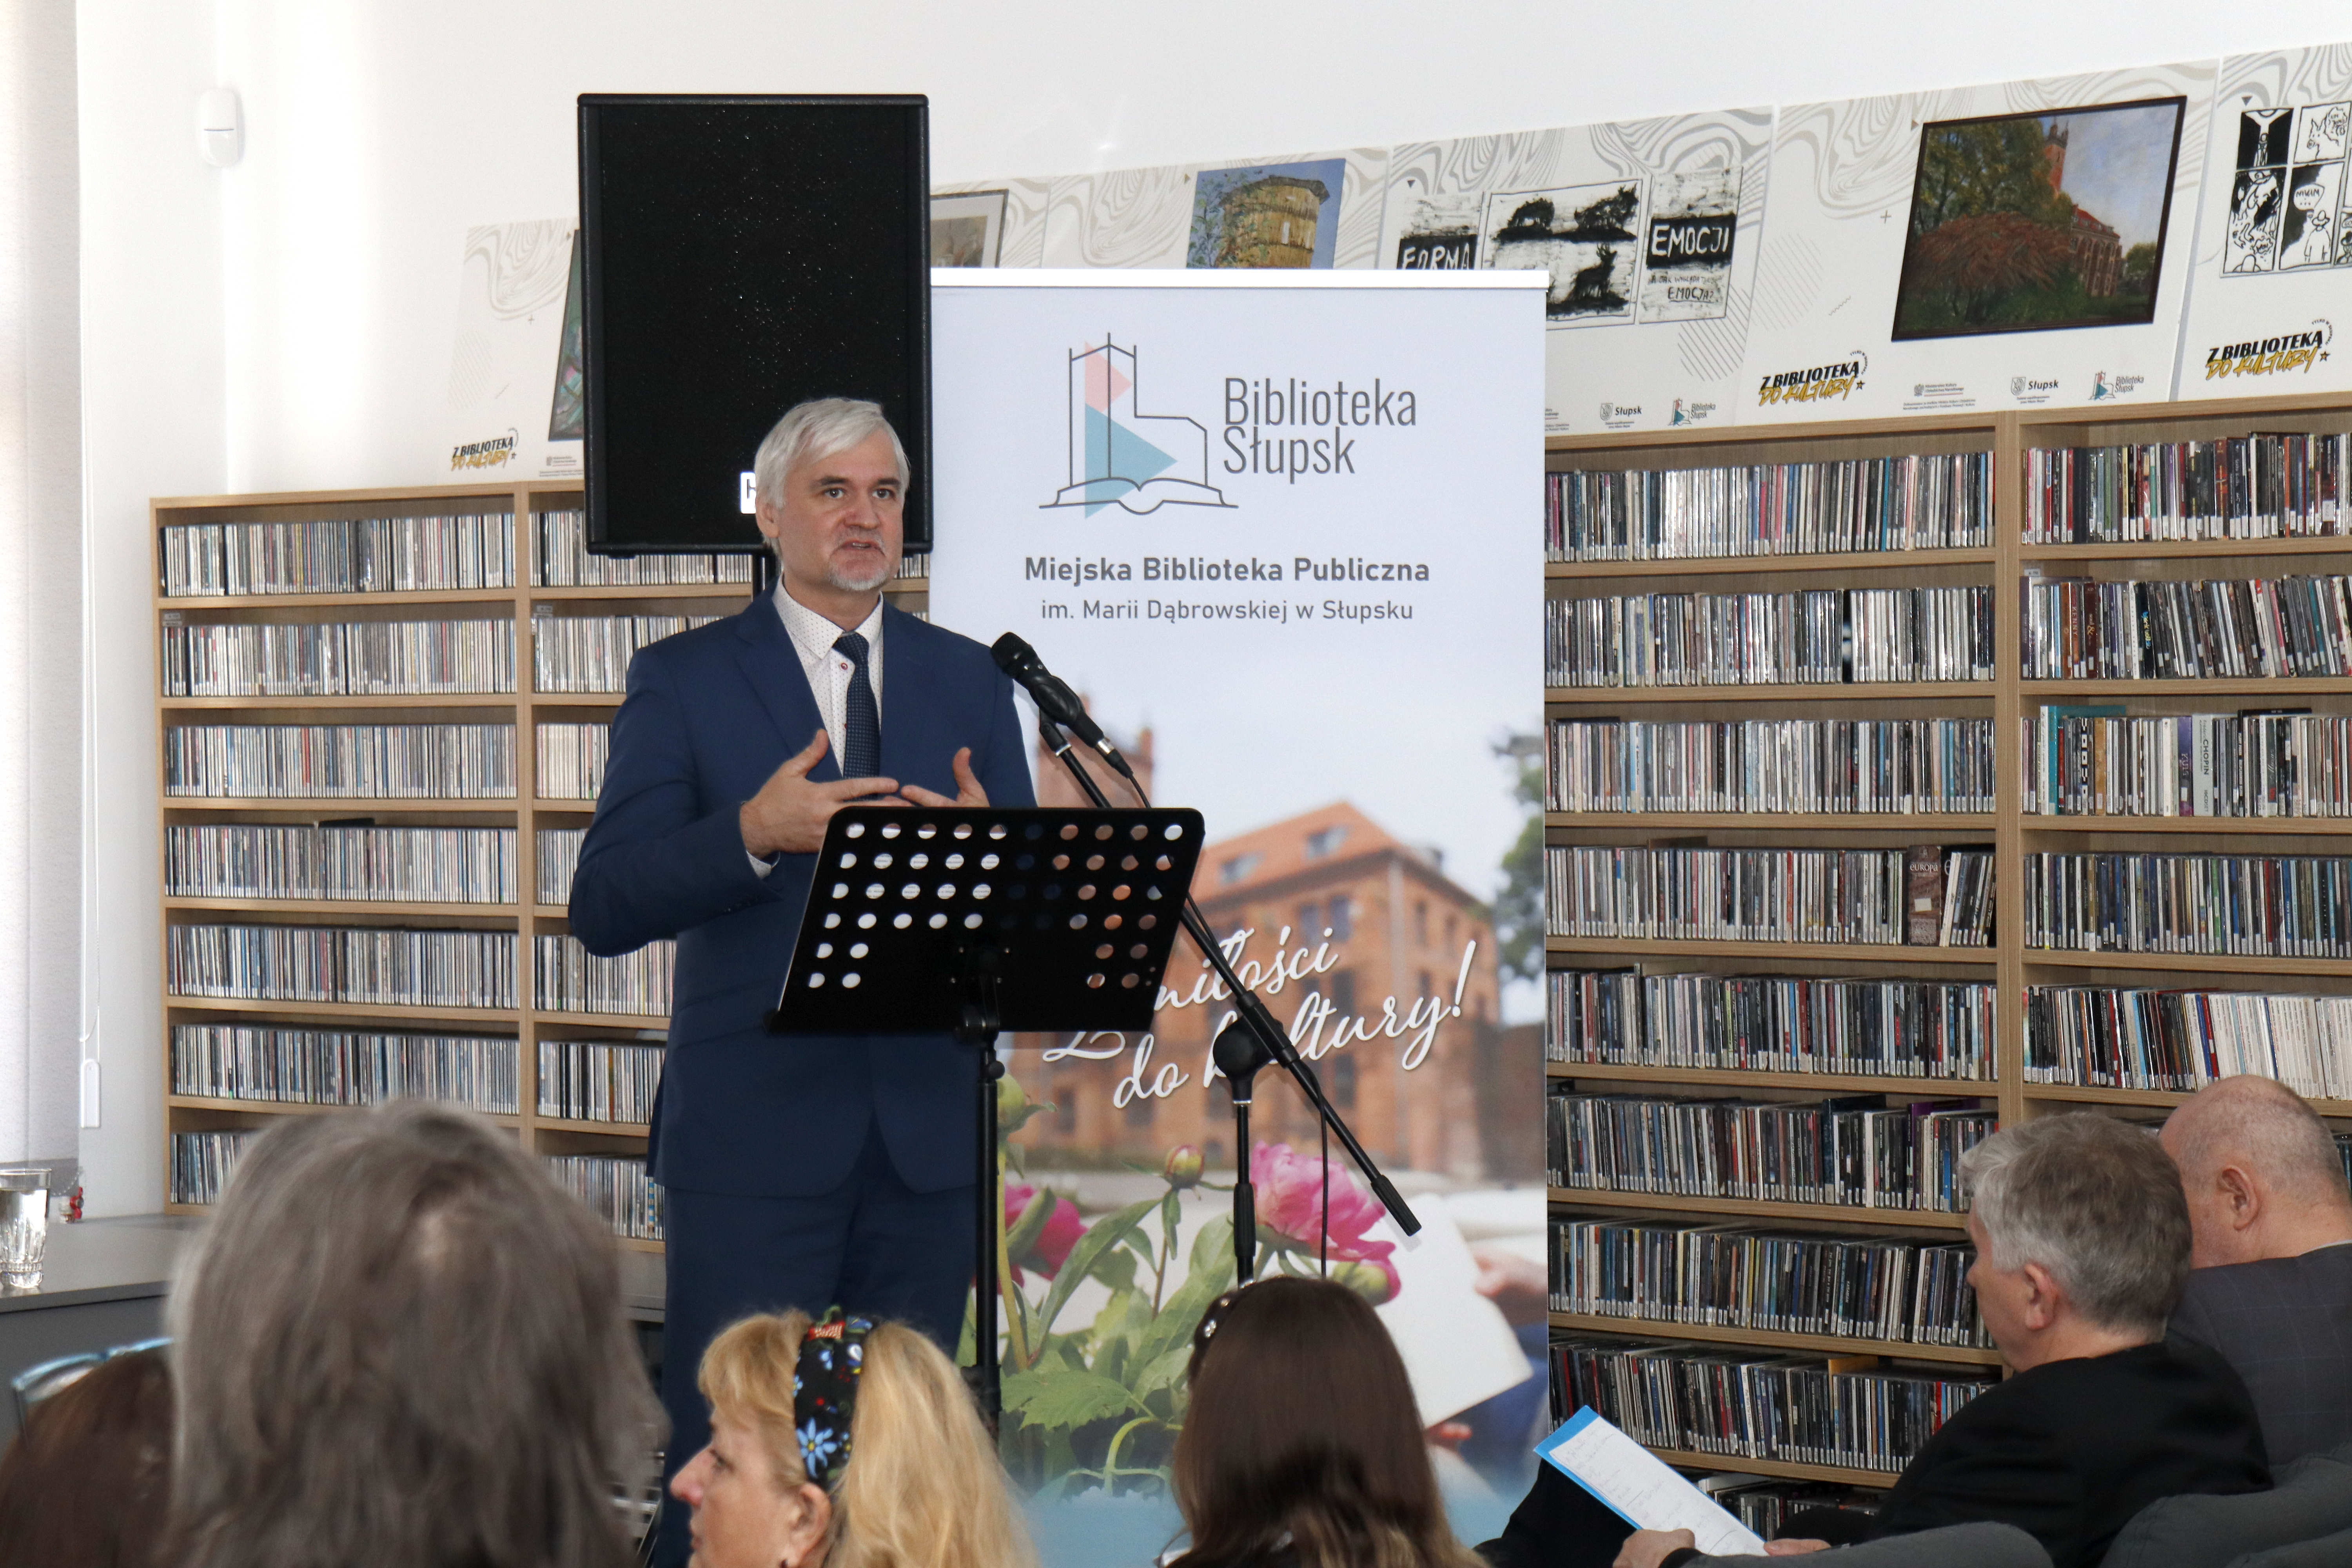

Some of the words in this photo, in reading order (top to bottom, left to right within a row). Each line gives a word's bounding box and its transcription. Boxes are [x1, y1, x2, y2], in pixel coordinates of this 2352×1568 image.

[1402, 242, 1470, 270] FORMA
[1651, 224, 1730, 258] EMOCJI
[2207, 348, 2219, 364] Z
[2222, 330, 2323, 361] BIBLIOTEKĄ
[1760, 376, 1772, 391] Z
[1773, 361, 1860, 388] BIBLIOTEKĄ
[2205, 358, 2233, 381] DO
[2233, 346, 2318, 377] KULTURY
[1758, 386, 1782, 407] DO
[1782, 376, 1855, 403] KULTURY
[2028, 379, 2059, 391] Słupsk
[2115, 384, 2134, 393] Słupsk
[2116, 375, 2144, 385] Biblioteka
[1225, 378, 1416, 427] Biblioteka
[1615, 406, 1642, 417] Słupsk
[1691, 403, 1716, 412] Biblioteka
[1223, 426, 1356, 485] Słupsk
[1025, 557, 1132, 587] Miejska
[1144, 557, 1283, 581] Biblioteka
[1295, 557, 1430, 582] Publiczna
[1042, 601, 1074, 619] im.
[1084, 600, 1138, 619] Marii
[1148, 600, 1287, 624] Dąbrowskiej
[1296, 606, 1314, 619] w
[1323, 600, 1413, 624] Słupsku
[1113, 1033, 1190, 1109] do
